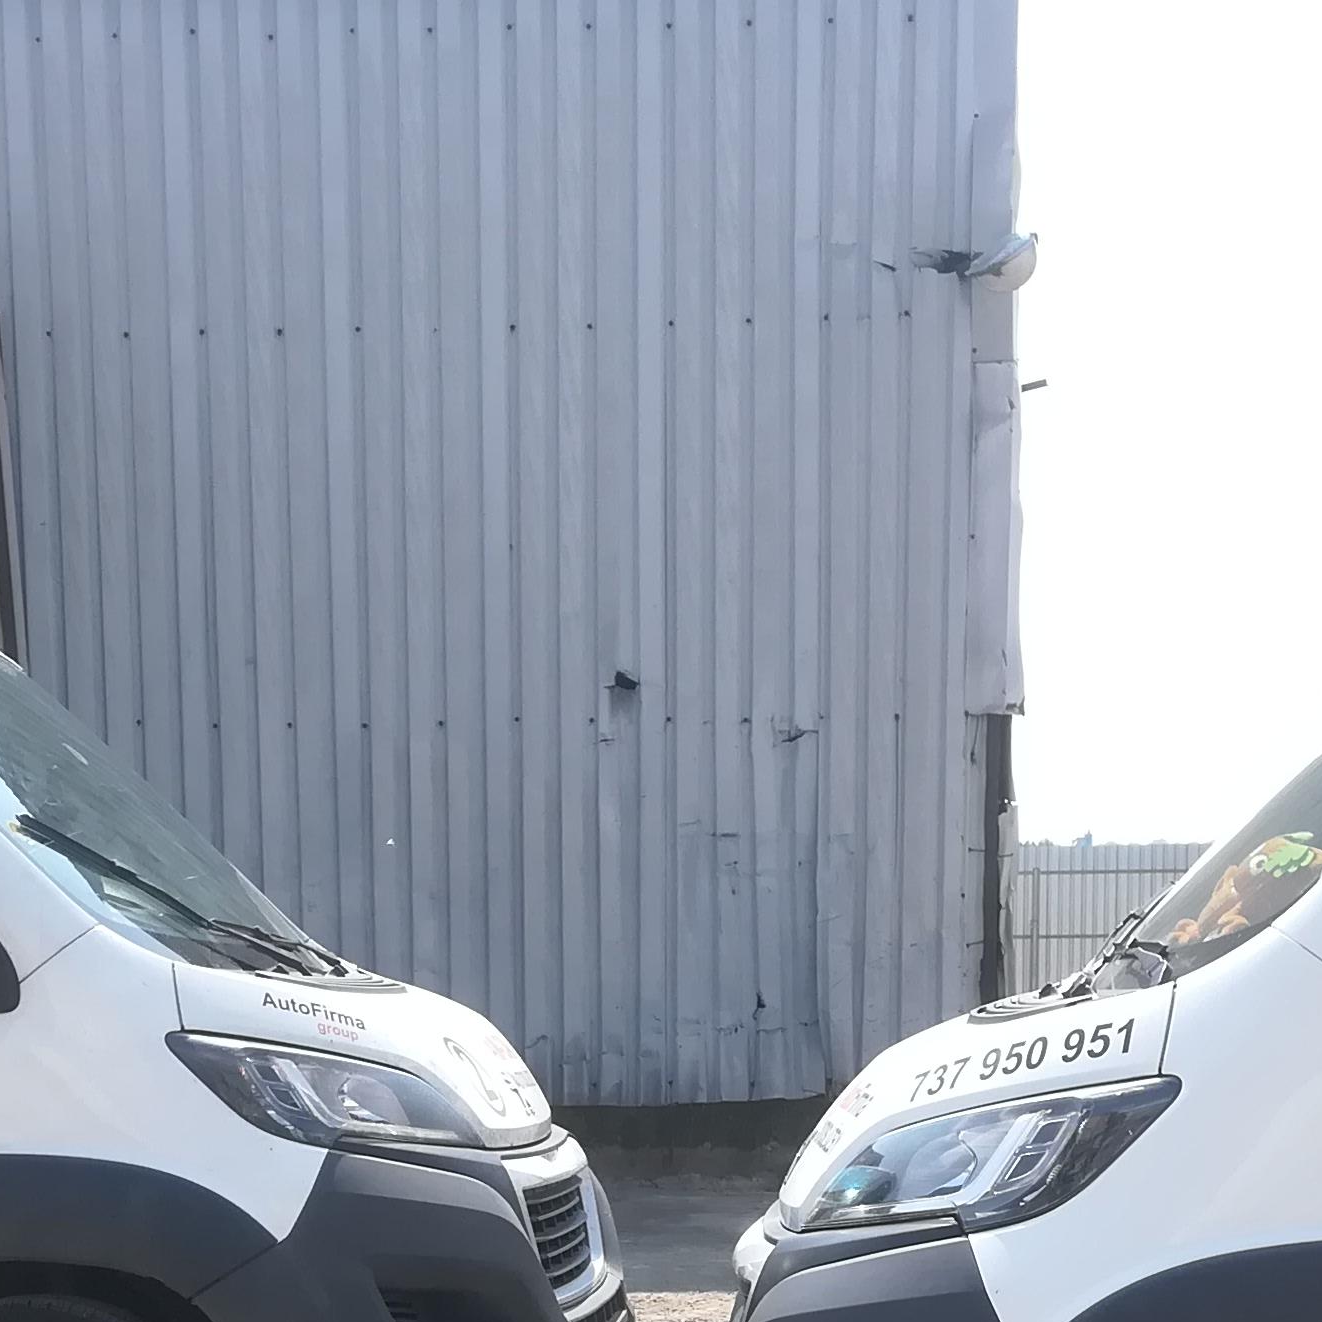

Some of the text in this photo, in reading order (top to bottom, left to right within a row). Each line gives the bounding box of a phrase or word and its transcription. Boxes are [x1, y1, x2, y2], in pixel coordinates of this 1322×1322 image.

[262, 992, 366, 1031] AutoFirma
[317, 1022, 359, 1042] group
[909, 1056, 972, 1103] 737
[979, 1036, 1049, 1082] 950
[1062, 1018, 1136, 1064] 951
